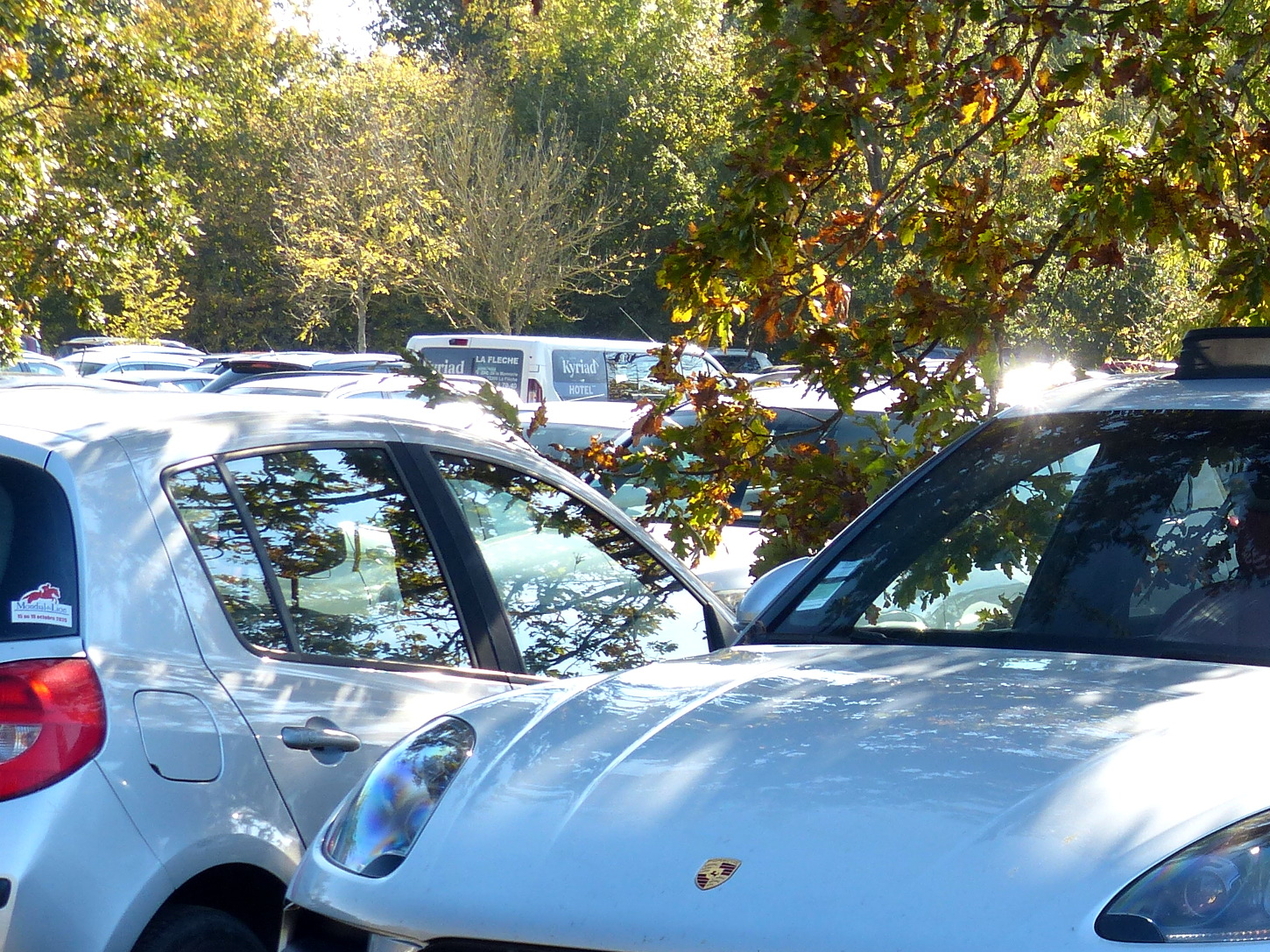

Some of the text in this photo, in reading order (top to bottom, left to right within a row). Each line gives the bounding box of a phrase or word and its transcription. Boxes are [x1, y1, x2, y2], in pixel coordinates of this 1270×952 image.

[475, 355, 519, 365] LA FLECHE
[562, 358, 598, 378] Kyriad
[569, 385, 594, 395] HOTEL
